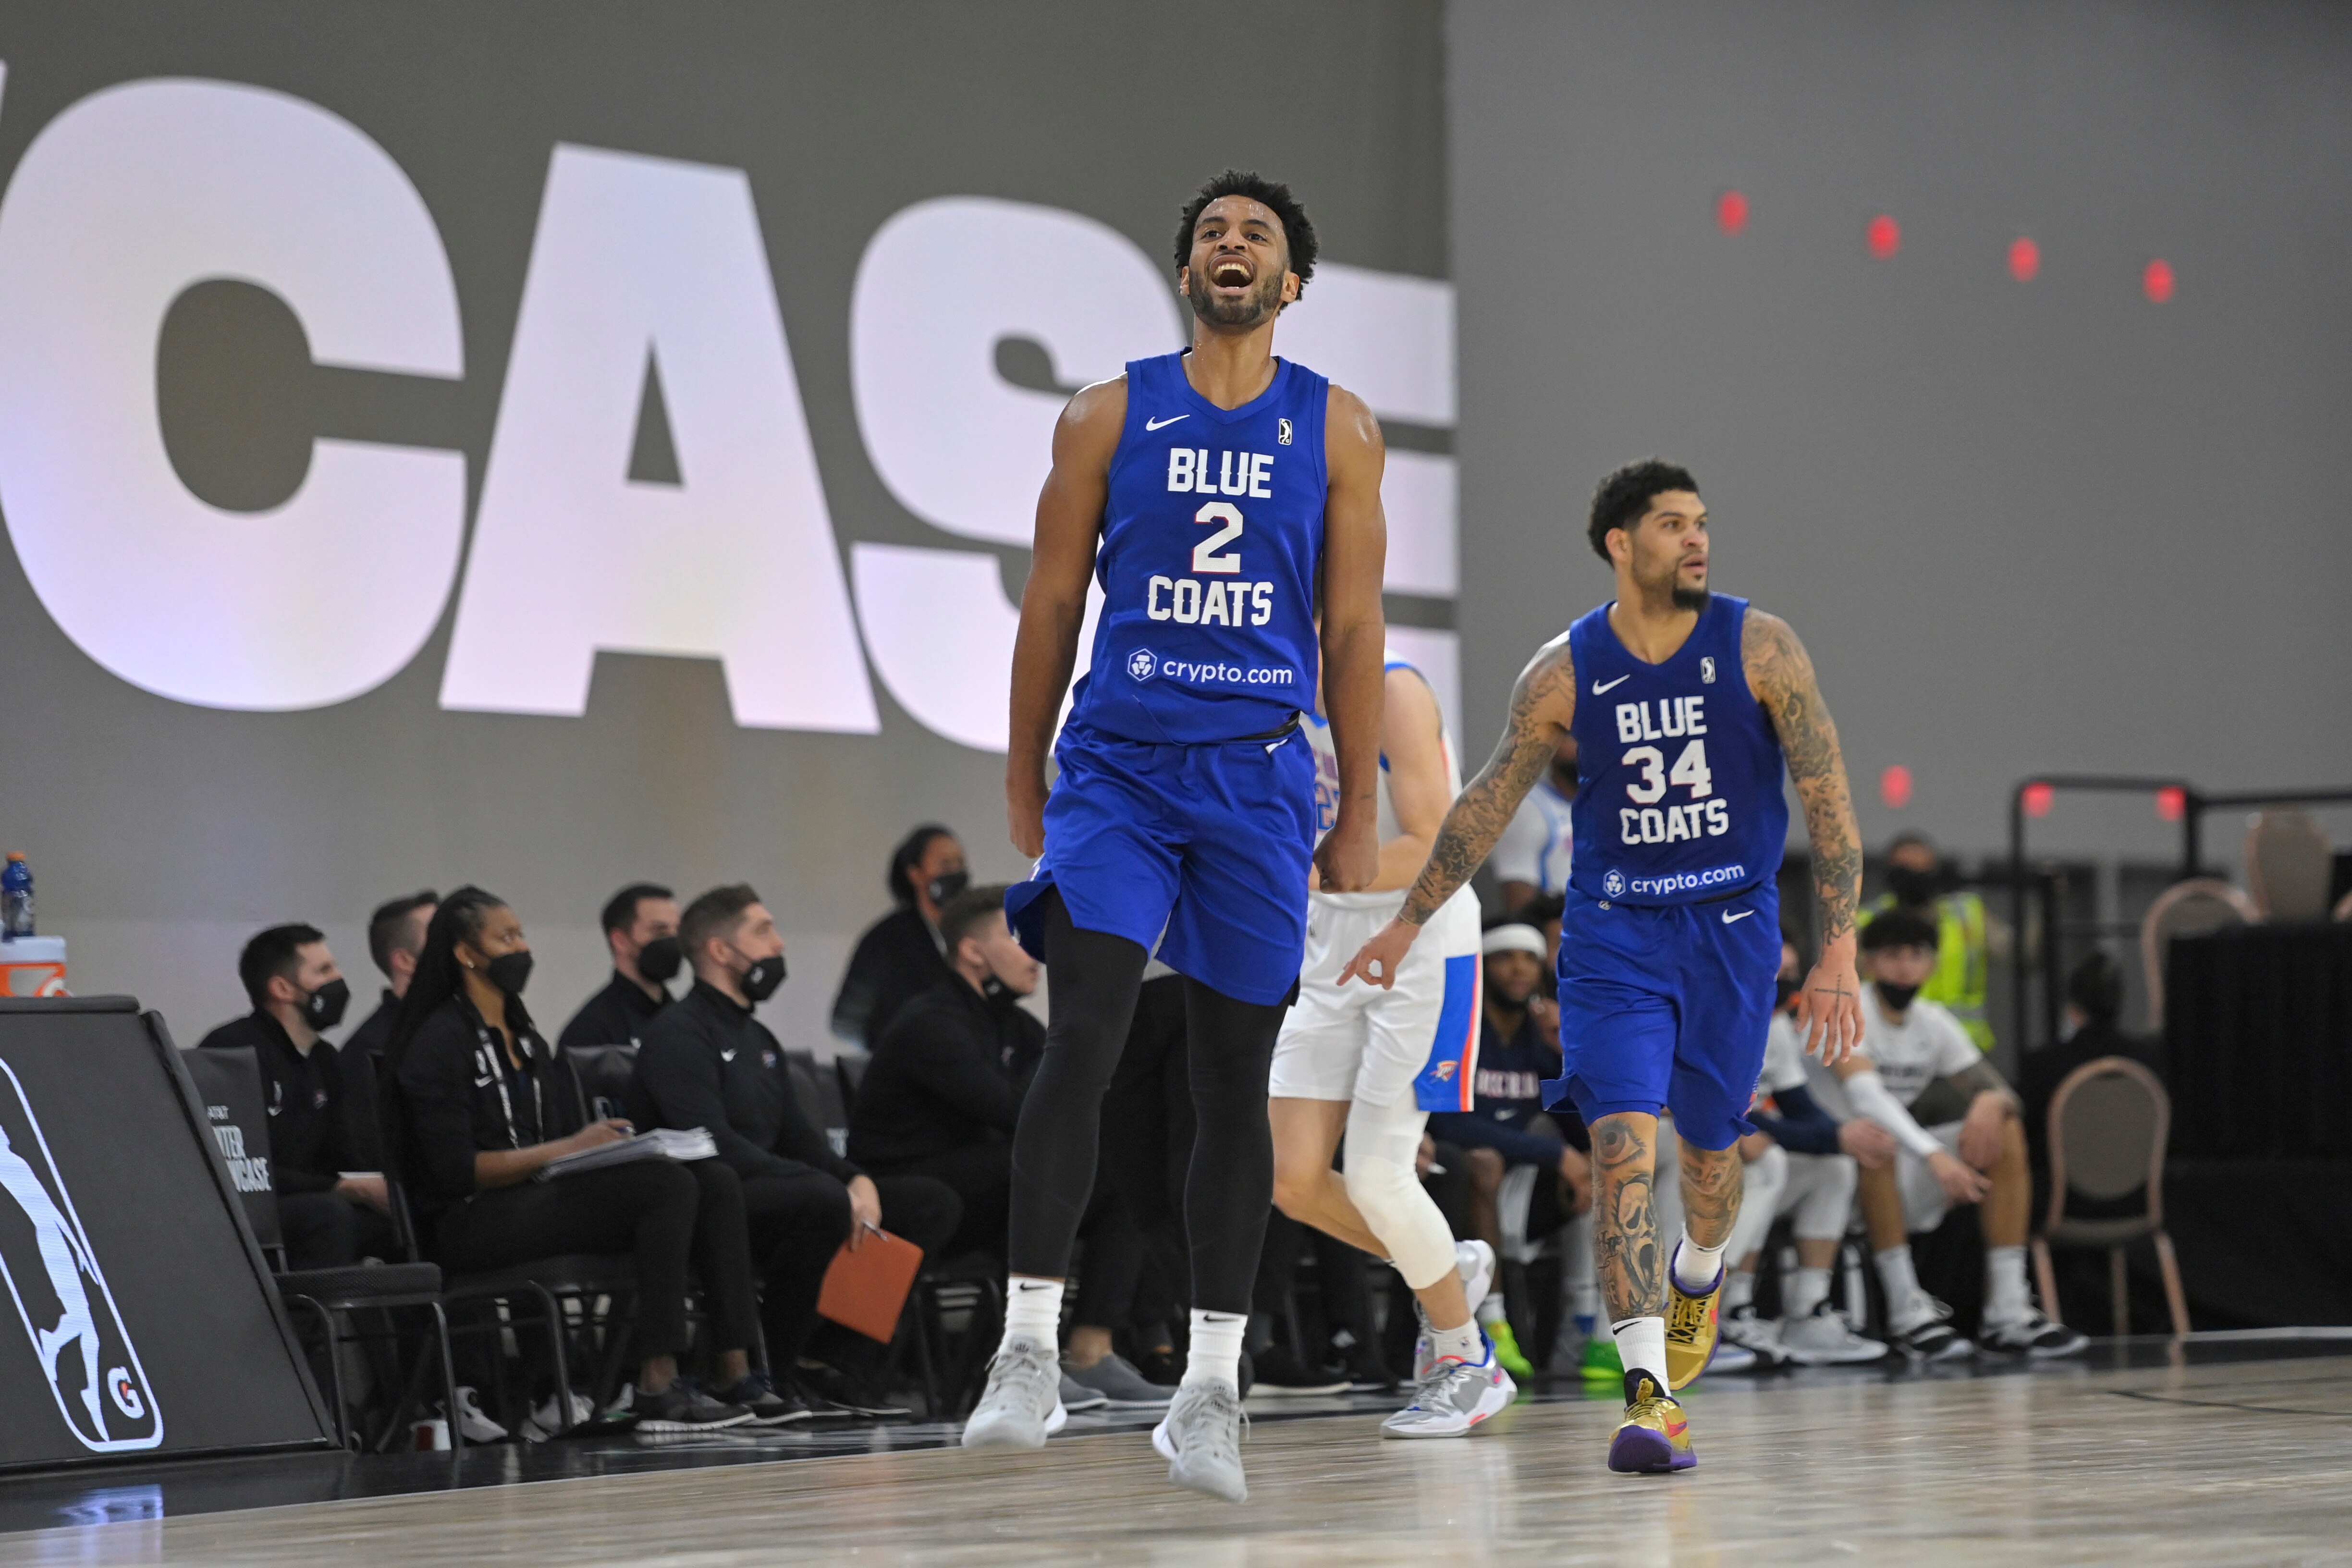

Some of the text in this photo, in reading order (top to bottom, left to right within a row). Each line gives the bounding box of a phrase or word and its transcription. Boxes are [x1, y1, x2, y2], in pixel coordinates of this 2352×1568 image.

[0, 59, 1459, 769] CASE
[1167, 447, 1274, 498] BLUE
[1191, 501, 1244, 574] 2
[1147, 575, 1274, 627] COATS
[1163, 661, 1293, 684] crypto.com
[1616, 695, 1708, 743] BLUE
[1621, 738, 1713, 806] 34
[1619, 798, 1729, 845] COATS
[1631, 864, 1745, 895] crypto.com
[107, 1366, 145, 1419] G
